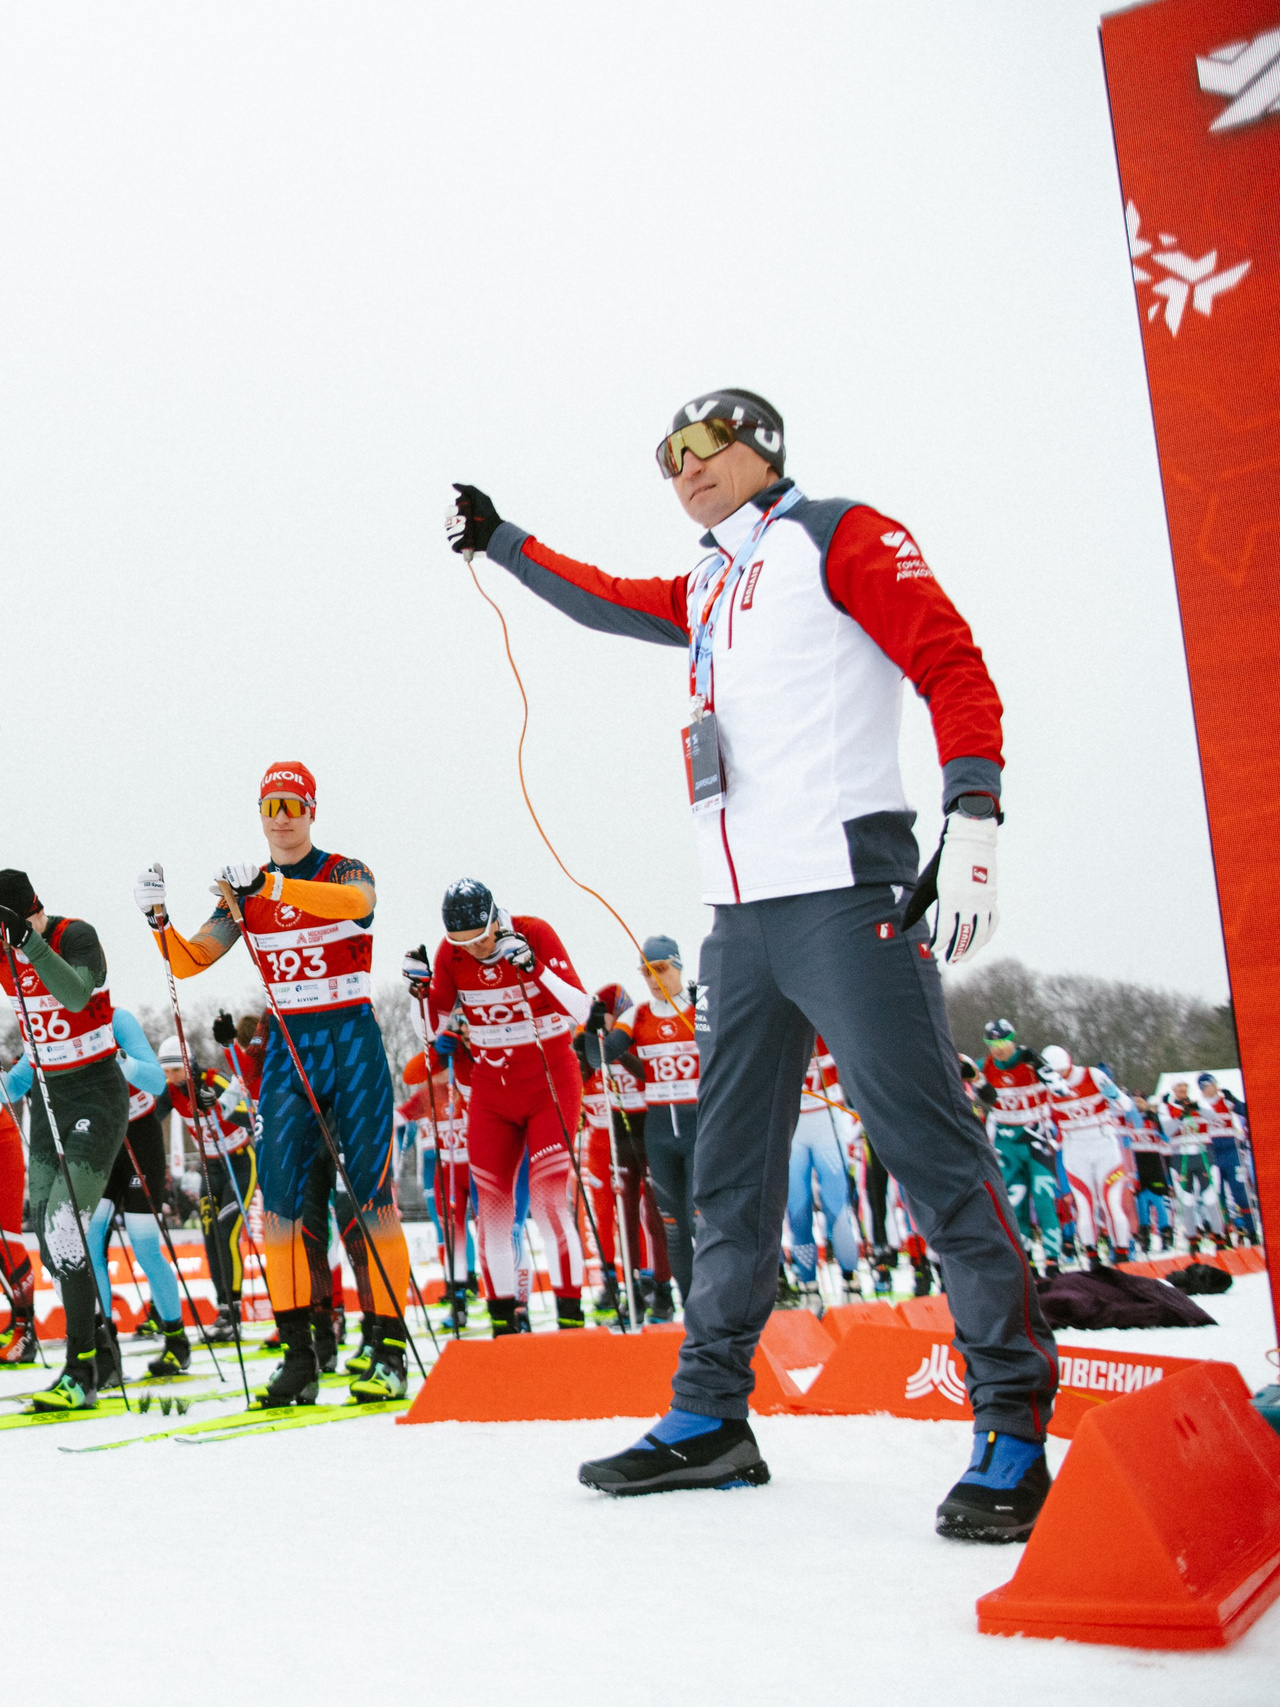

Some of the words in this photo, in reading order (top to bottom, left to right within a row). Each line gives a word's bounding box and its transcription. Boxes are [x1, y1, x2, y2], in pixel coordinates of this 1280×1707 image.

[742, 564, 762, 606] BIVIUM
[266, 946, 328, 982] 193
[649, 1054, 696, 1082] 189
[31, 1411, 70, 1423] FISCHER
